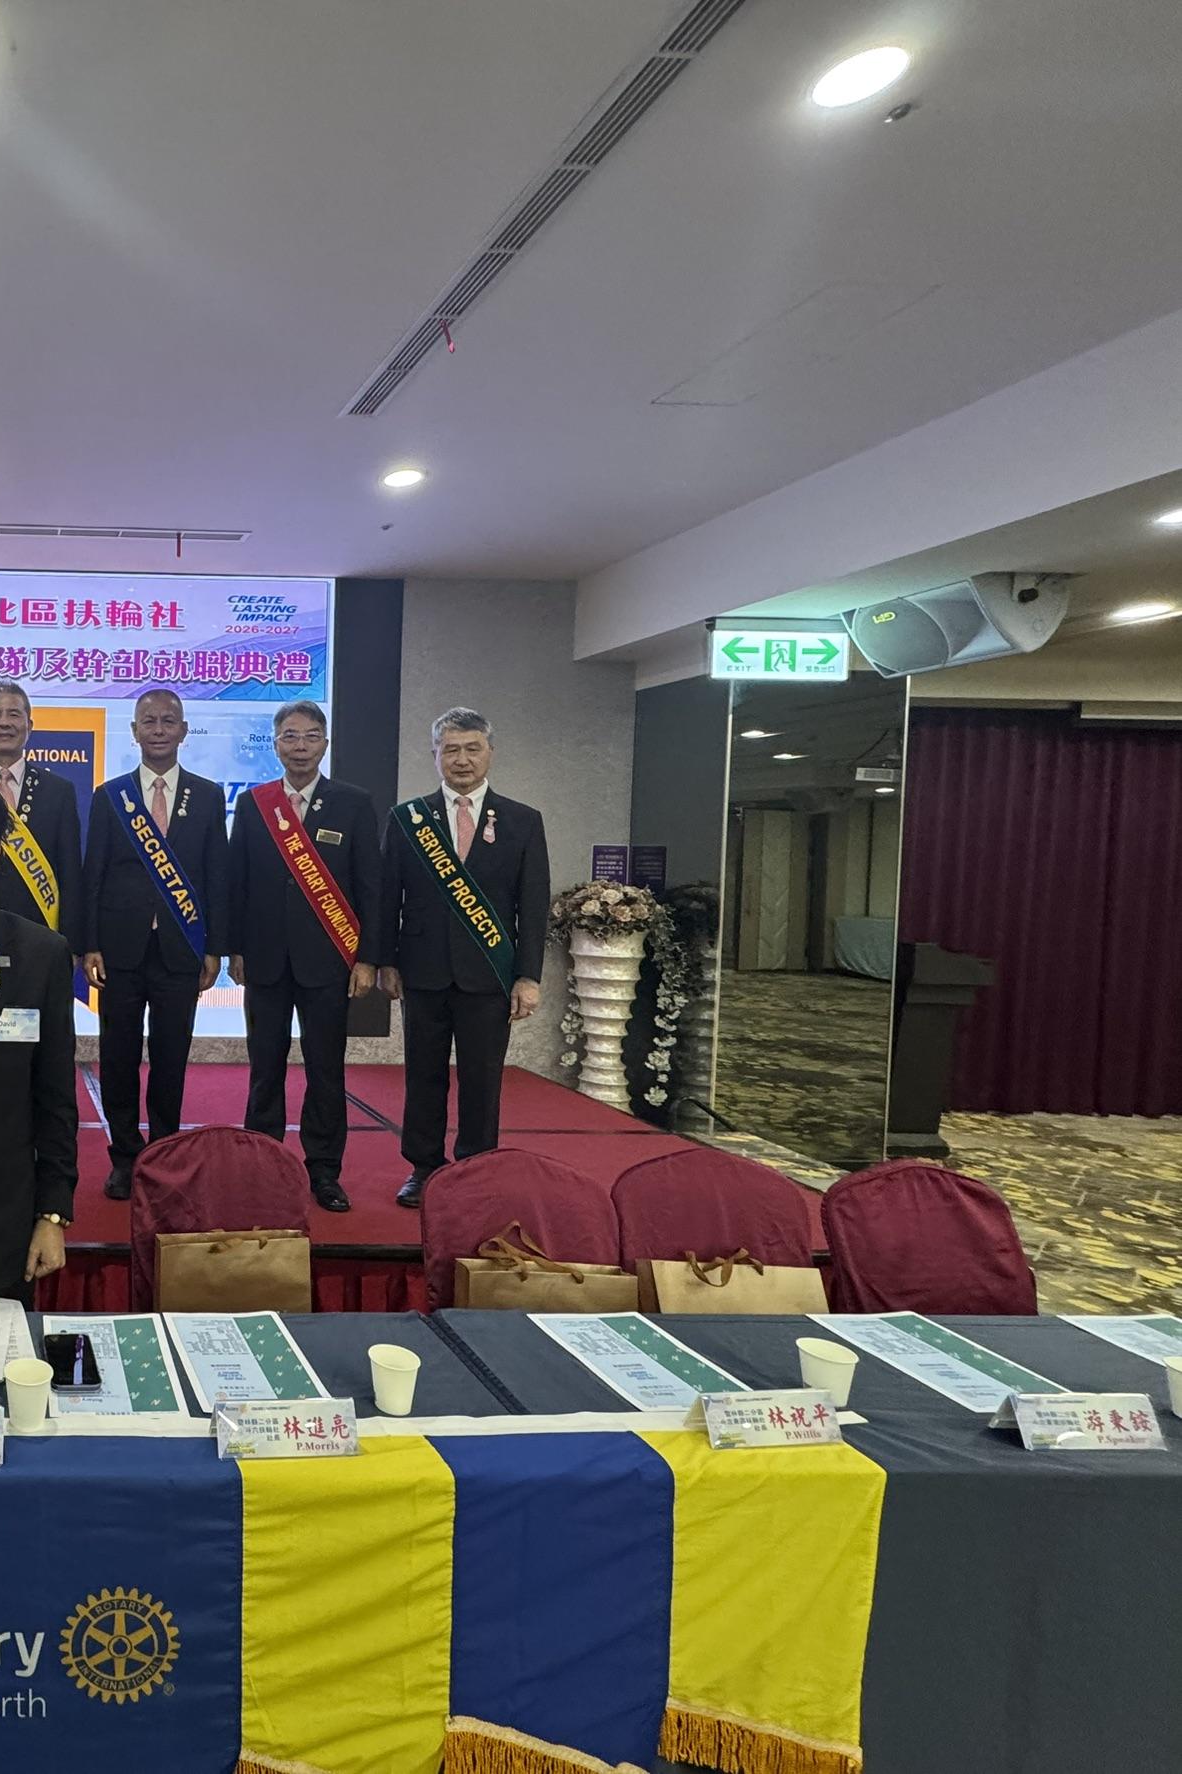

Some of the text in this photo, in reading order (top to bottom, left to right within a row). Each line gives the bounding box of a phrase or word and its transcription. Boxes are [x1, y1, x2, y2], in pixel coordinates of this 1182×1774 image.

[227, 595, 284, 604] CREATE
[232, 604, 297, 613] LASTING
[236, 613, 294, 622] IMPACT
[225, 625, 300, 634] 2026-2027
[249, 733, 273, 743] Rota
[130, 813, 199, 925] SECRETARY
[283, 832, 304, 855] THE
[294, 853, 328, 894] ROTARY
[9, 836, 57, 911] ASURER
[415, 825, 502, 949] SERVICE PROJECTS
[296, 1441, 340, 1451] P.Morris
[94, 1600, 146, 1616] ROTARY
[78, 1660, 163, 1692] INTERNATIONAL
